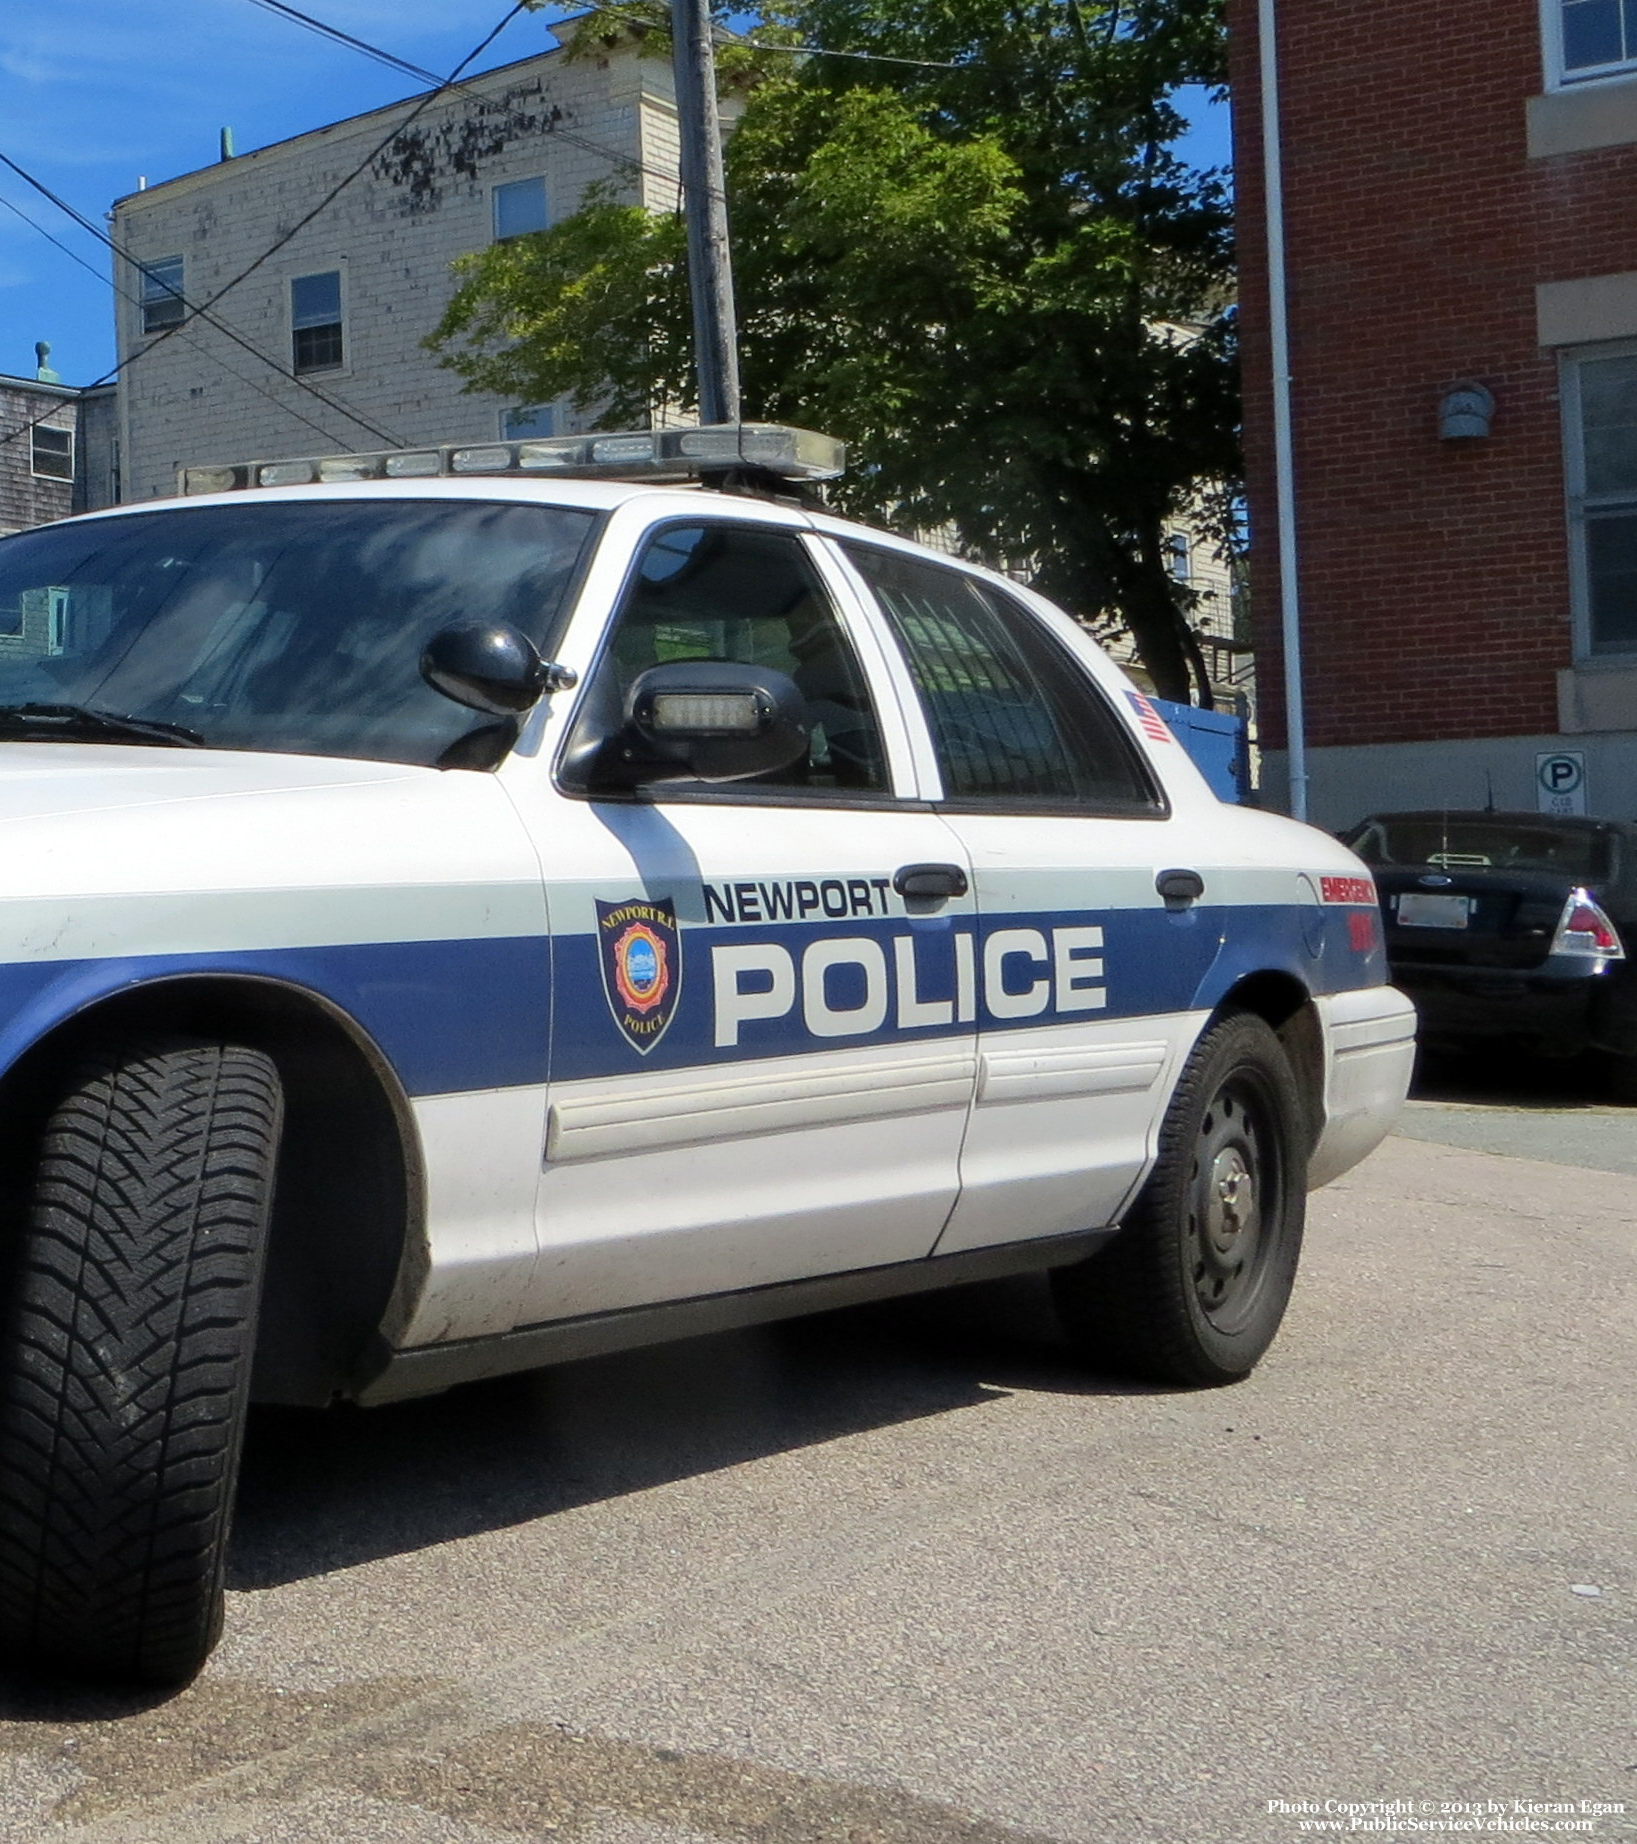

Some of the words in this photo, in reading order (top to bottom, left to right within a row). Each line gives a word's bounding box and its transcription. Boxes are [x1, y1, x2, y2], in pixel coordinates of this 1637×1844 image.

[1551, 762, 1573, 788] P
[703, 878, 891, 924] NEWPORT
[601, 905, 655, 929] NEWPORT
[711, 925, 1107, 1048] POLICE
[623, 1012, 666, 1034] POLICE
